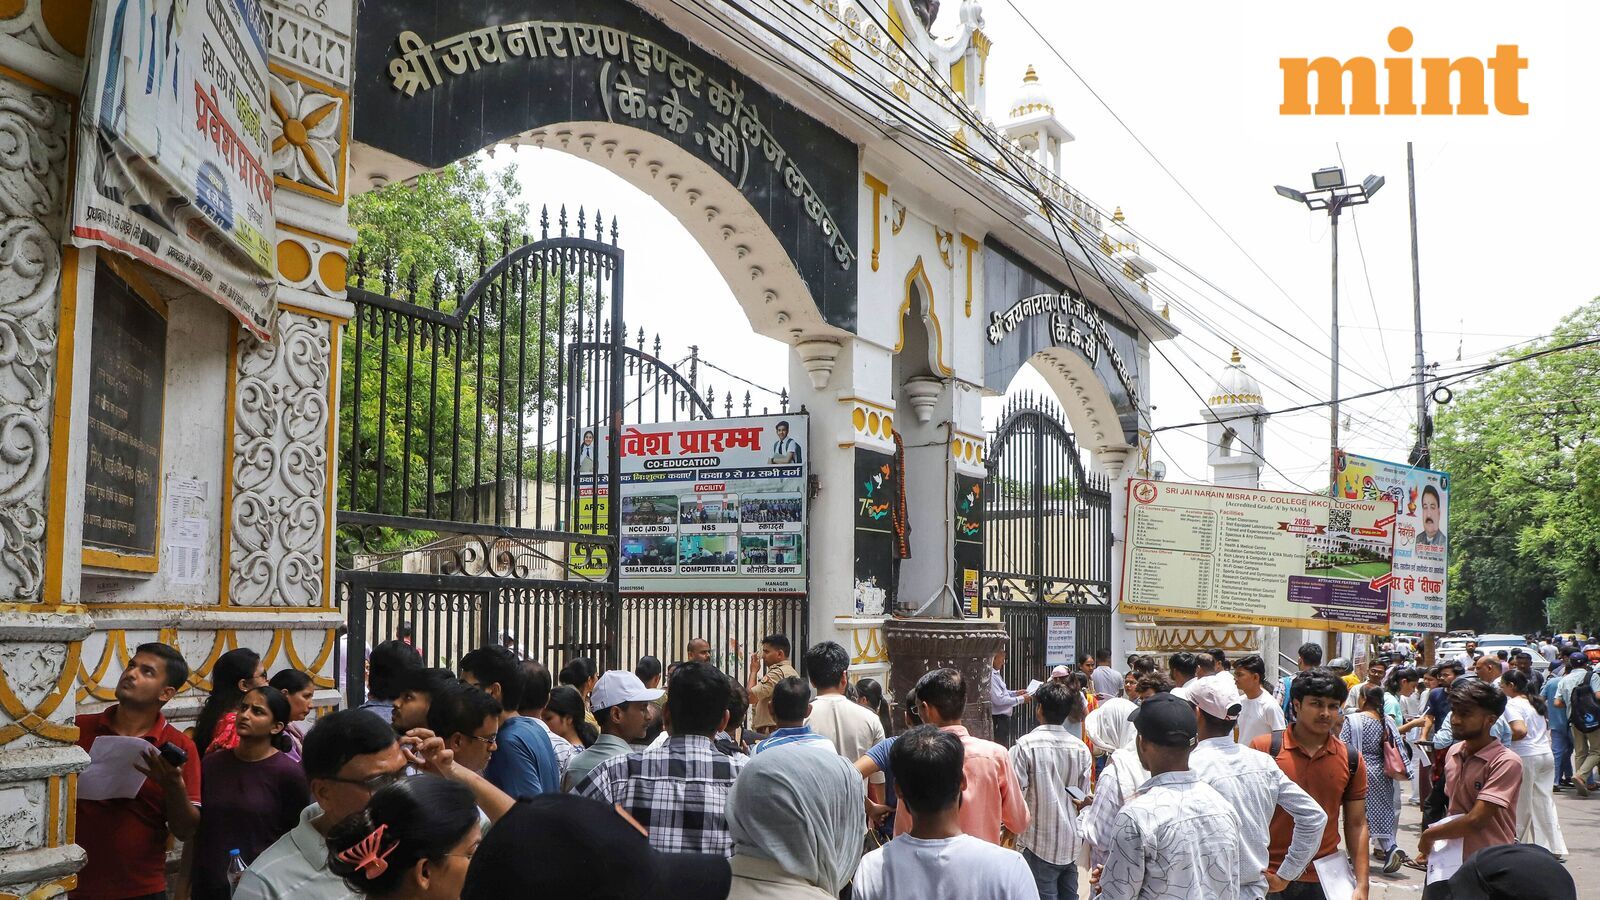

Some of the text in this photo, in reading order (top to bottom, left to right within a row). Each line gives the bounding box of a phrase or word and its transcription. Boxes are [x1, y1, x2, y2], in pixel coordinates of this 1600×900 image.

[195, 79, 236, 174] प्रवेश
[389, 31, 443, 97] श्री
[628, 34, 704, 98] इण्टर
[708, 79, 786, 172] कॉलेज
[783, 157, 857, 271] लखनऊ
[989, 311, 1004, 345] श्री
[605, 428, 673, 458] वेश
[646, 458, 718, 468] CO-EDUCATION
[700, 471, 723, 480] कक्षा
[733, 469, 743, 478] से
[746, 470, 756, 478] 12
[758, 467, 780, 478] सभी
[695, 484, 724, 492] FACILITY
[1194, 489, 1224, 498] NARAIN
[1226, 492, 1250, 500] MISRA
[1269, 496, 1306, 505] COLLEGE
[1334, 502, 1375, 511] LUCKNOW
[1403, 574, 1415, 595] दुबे
